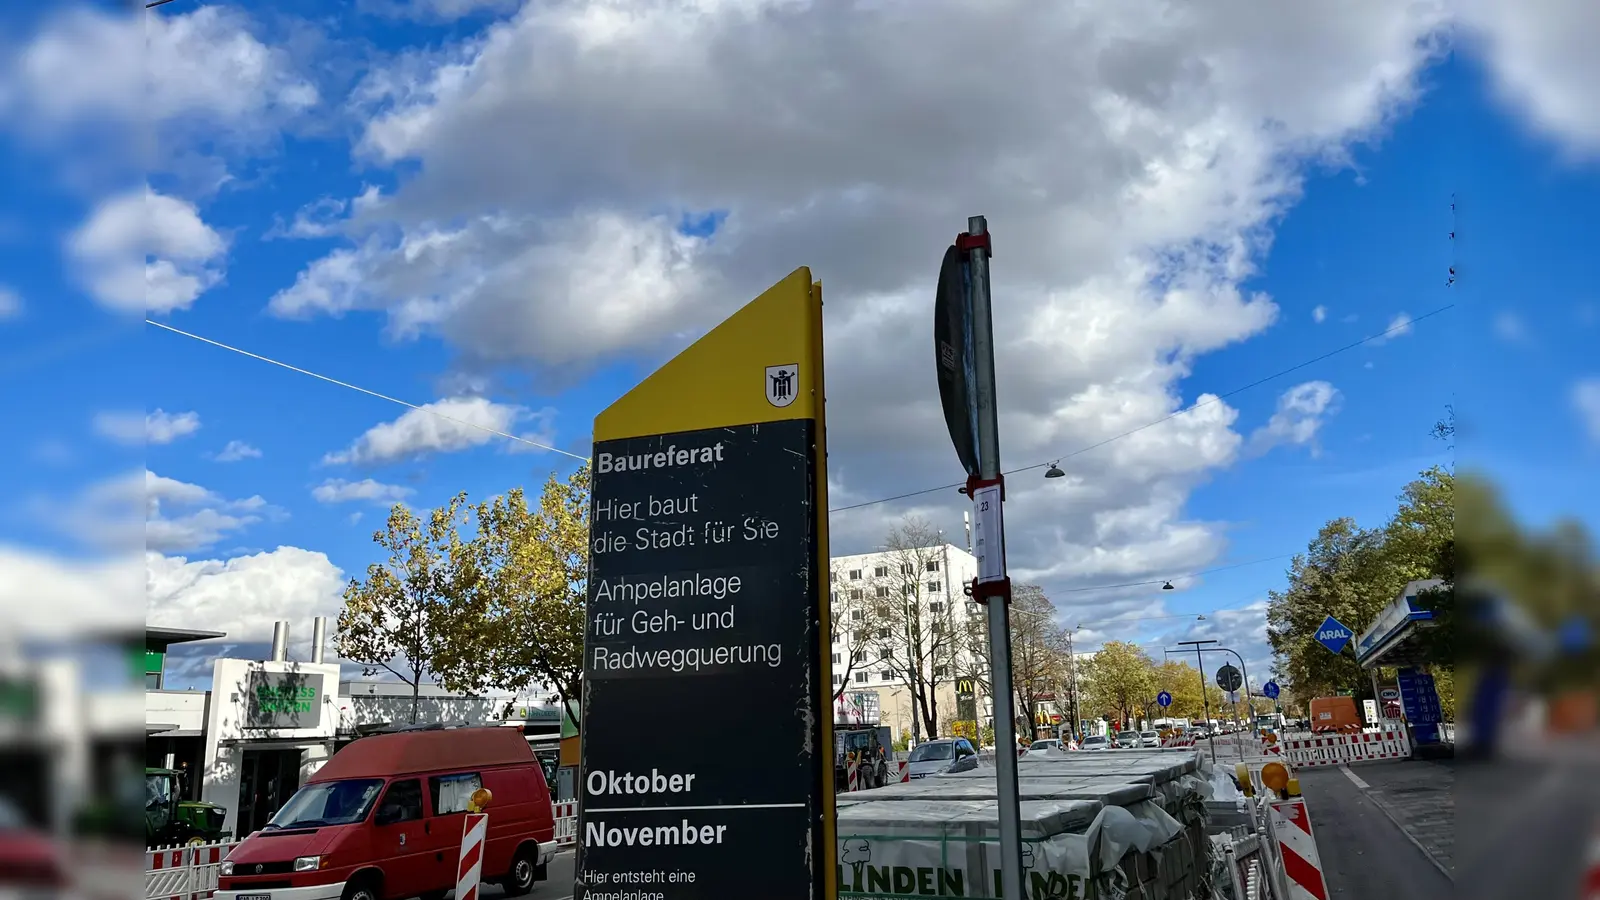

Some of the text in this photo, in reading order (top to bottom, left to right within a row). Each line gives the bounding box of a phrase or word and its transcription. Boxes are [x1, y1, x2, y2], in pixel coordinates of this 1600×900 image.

[598, 442, 724, 474] Baureferat
[595, 493, 698, 521] Hier baut
[594, 517, 779, 554] die Stadt für Sie
[595, 573, 741, 604] Ampelanlage
[593, 605, 735, 636] für Geh- und
[1319, 629, 1349, 641] ARAL
[593, 642, 782, 671] Radwegquerung
[586, 768, 695, 796] Oktober
[585, 819, 727, 848] November
[583, 869, 696, 884] Hier entsteht eine
[838, 864, 965, 897] LINDEN
